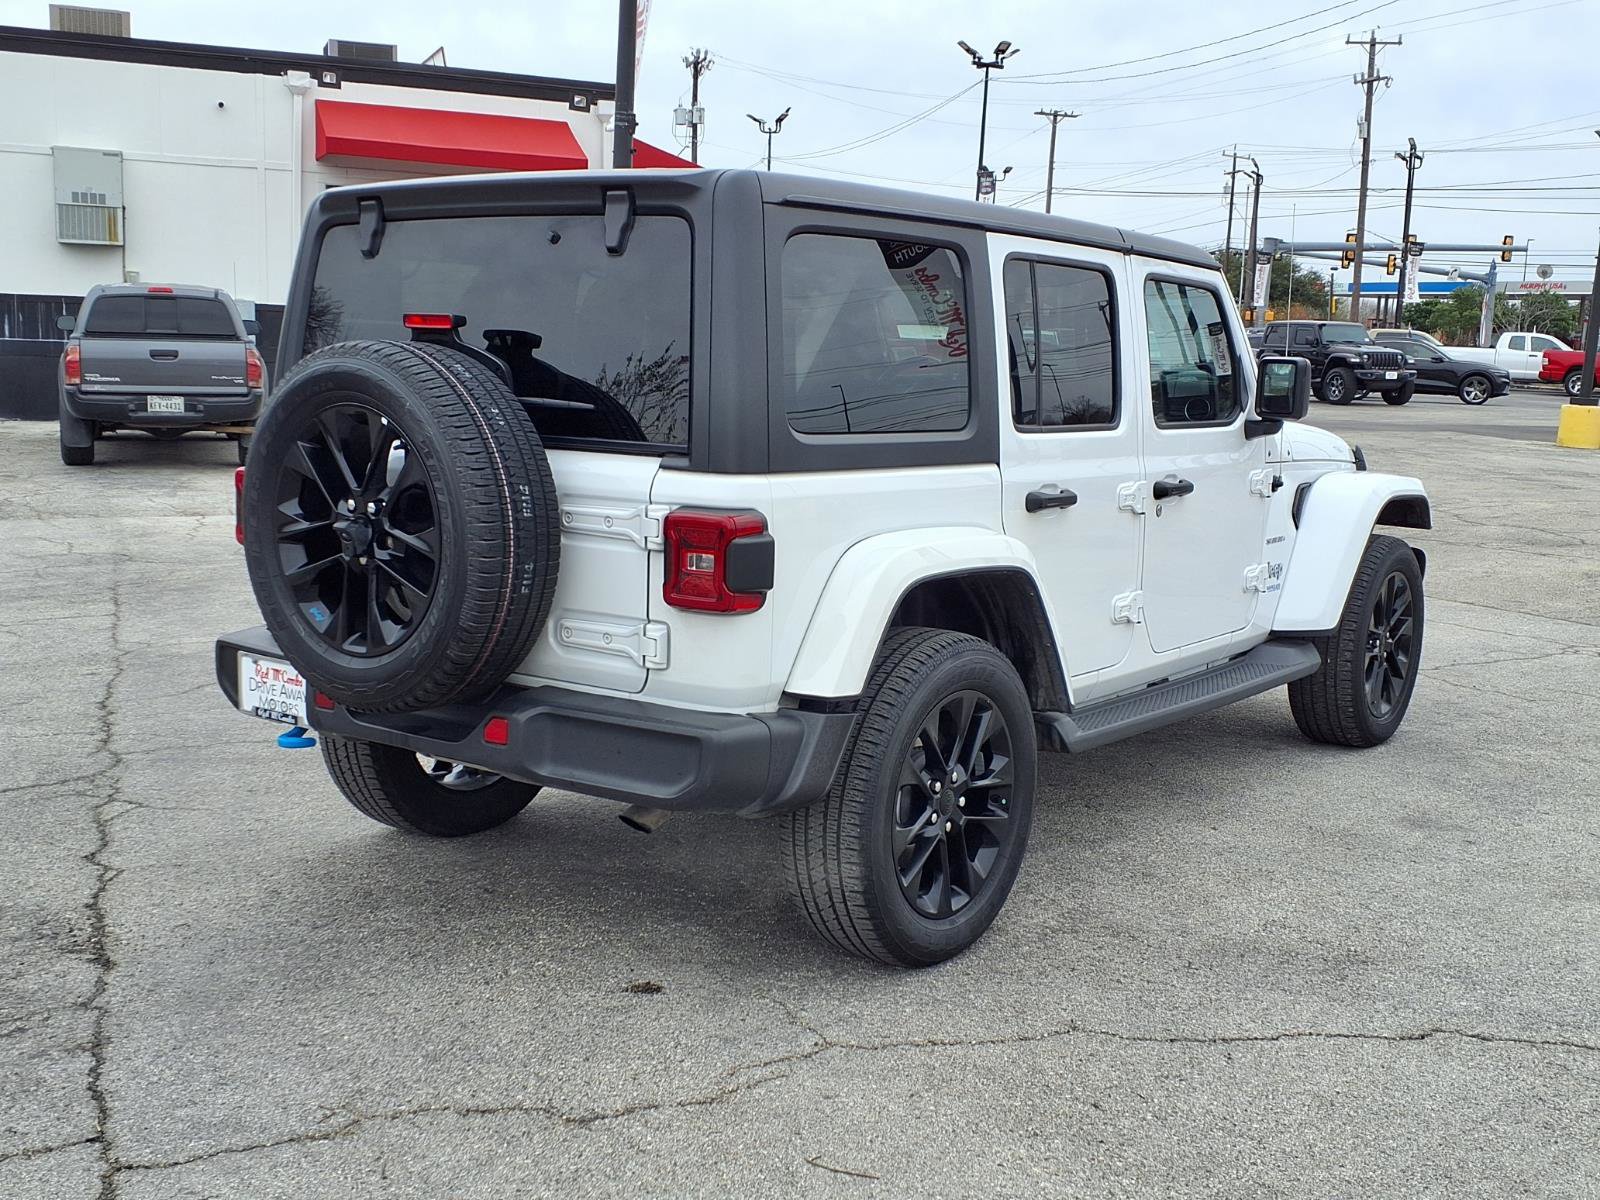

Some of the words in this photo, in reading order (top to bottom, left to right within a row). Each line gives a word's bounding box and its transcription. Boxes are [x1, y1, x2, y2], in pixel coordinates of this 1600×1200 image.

[1519, 282, 1547, 290] MURPHY
[255, 663, 270, 684] Red
[249, 677, 278, 697] DRIVE
[259, 695, 300, 716] MOTORS
